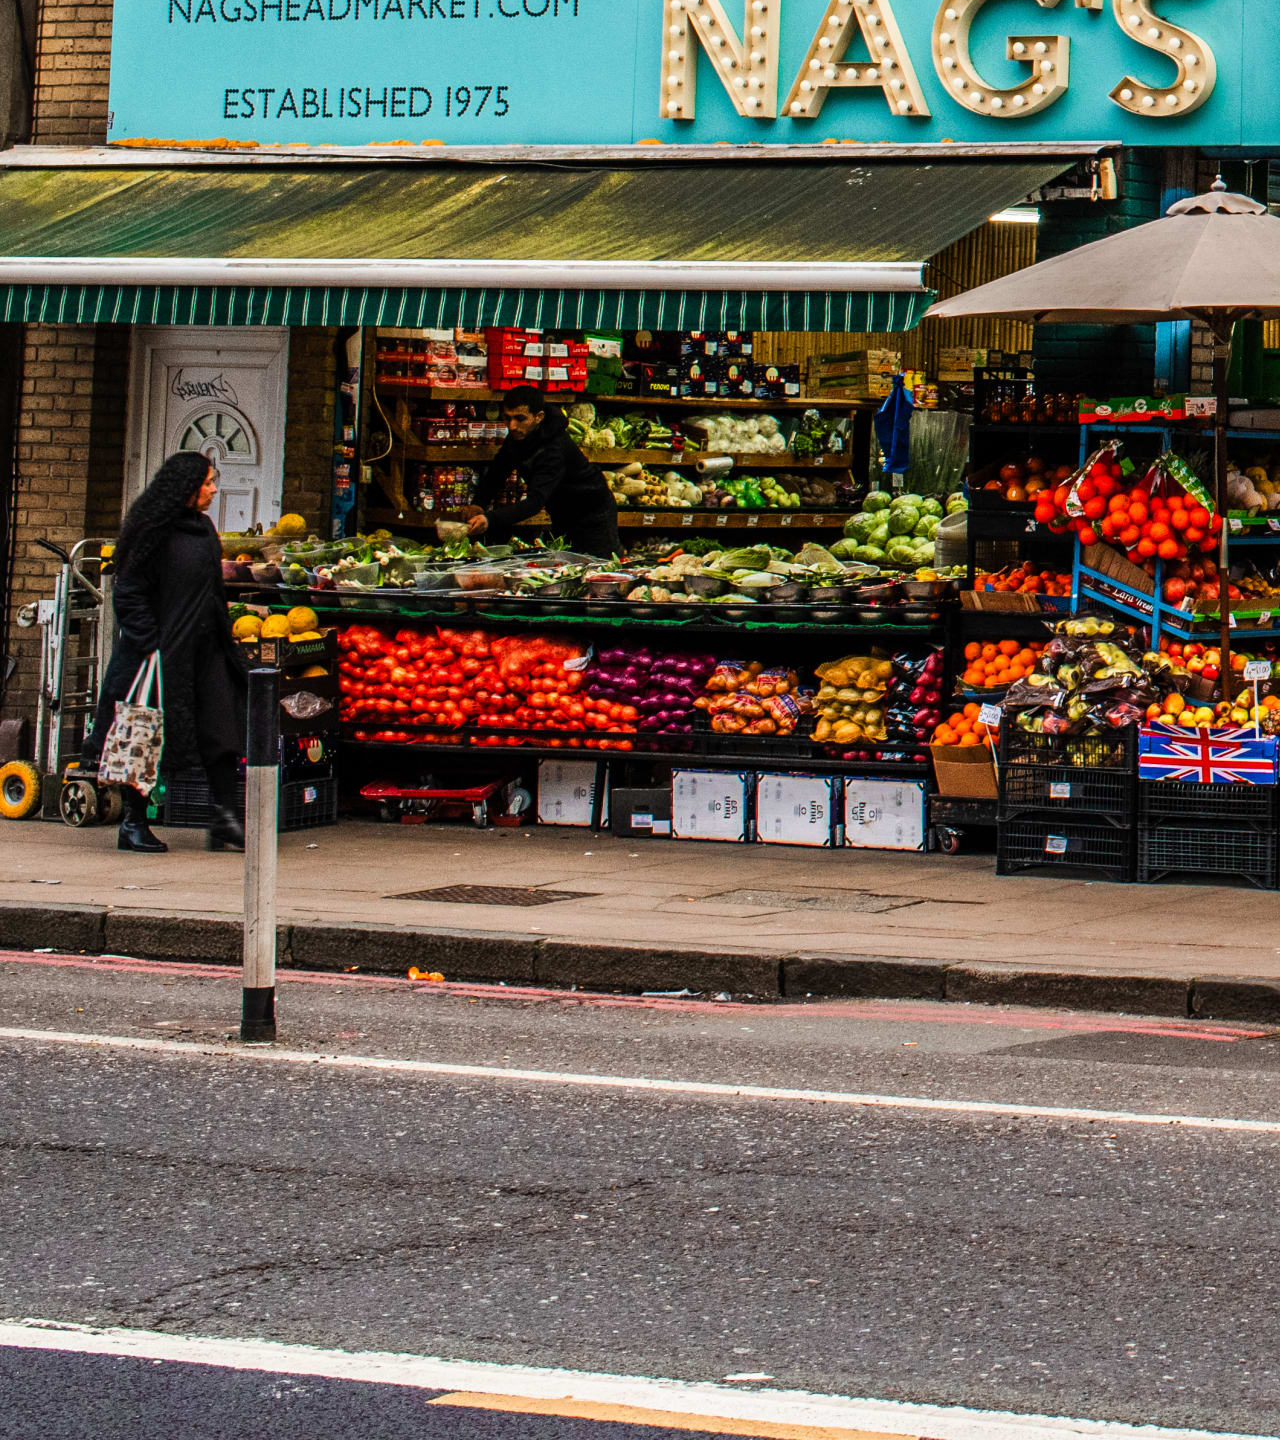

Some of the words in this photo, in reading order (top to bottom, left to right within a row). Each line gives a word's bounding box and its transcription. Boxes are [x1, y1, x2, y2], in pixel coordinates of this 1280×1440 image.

[223, 86, 433, 120] ESTABLISHED
[445, 86, 510, 118] 1975
[649, 381, 670, 392] renova
[295, 642, 326, 655] YAMAMA
